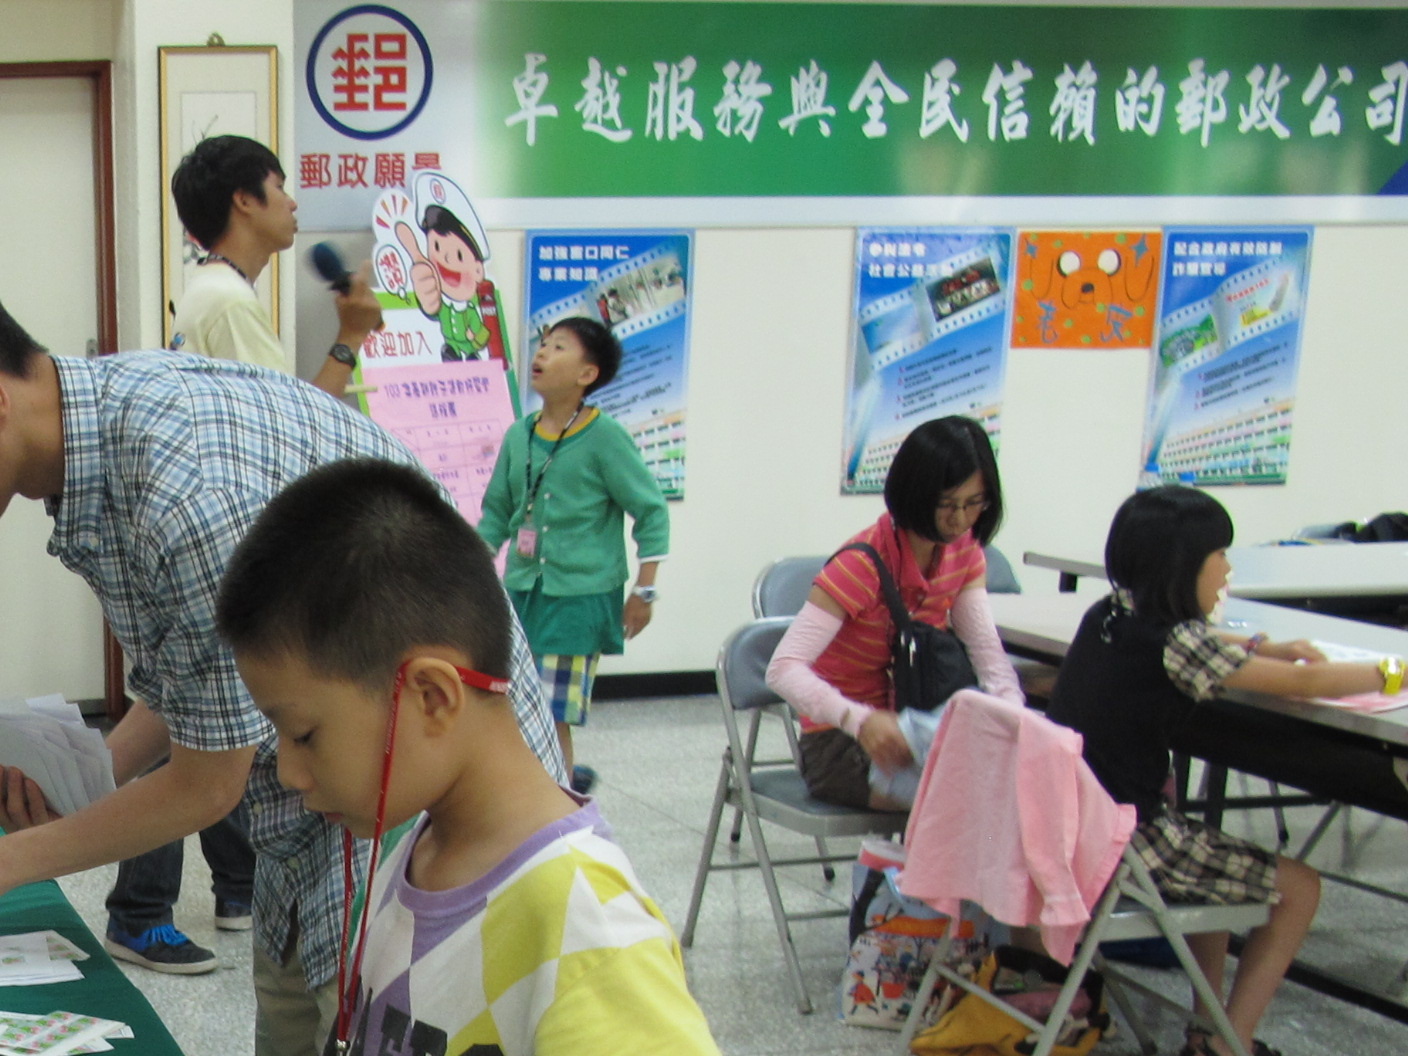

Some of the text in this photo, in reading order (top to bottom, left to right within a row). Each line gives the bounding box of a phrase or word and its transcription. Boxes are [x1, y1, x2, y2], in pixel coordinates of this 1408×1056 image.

[504, 52, 1408, 149] 卓越服務與全民信賴的郵政公司
[363, 329, 433, 359] 歡迎加入
